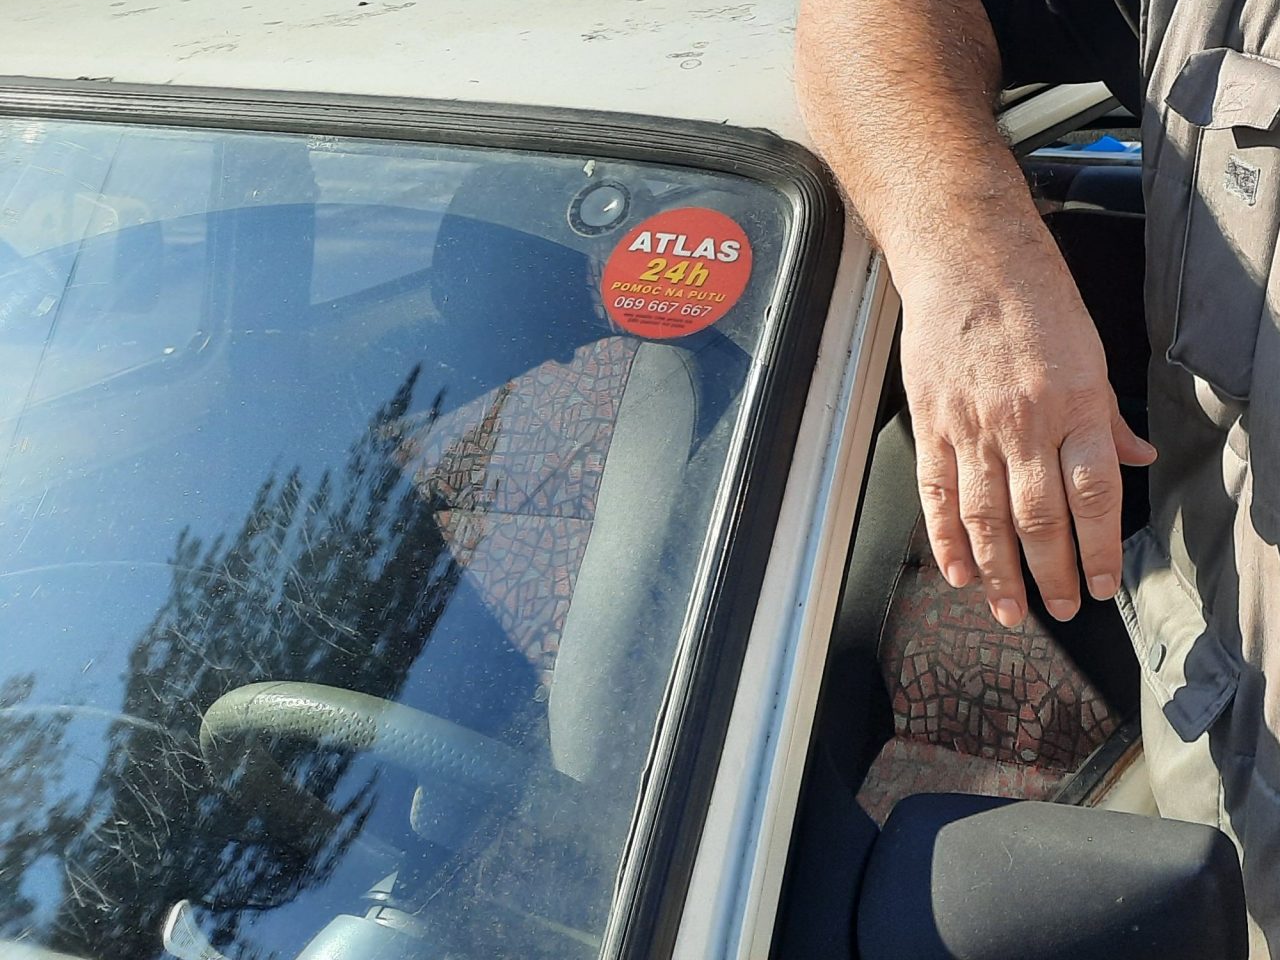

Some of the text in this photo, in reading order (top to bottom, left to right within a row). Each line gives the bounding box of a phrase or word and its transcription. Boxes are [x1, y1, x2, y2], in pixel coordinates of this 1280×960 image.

[628, 231, 741, 262] ATLAS
[639, 257, 711, 287] 24h
[613, 296, 712, 317] 069 667 667
[665, 288, 684, 298] NA
[687, 290, 726, 302] PUTU
